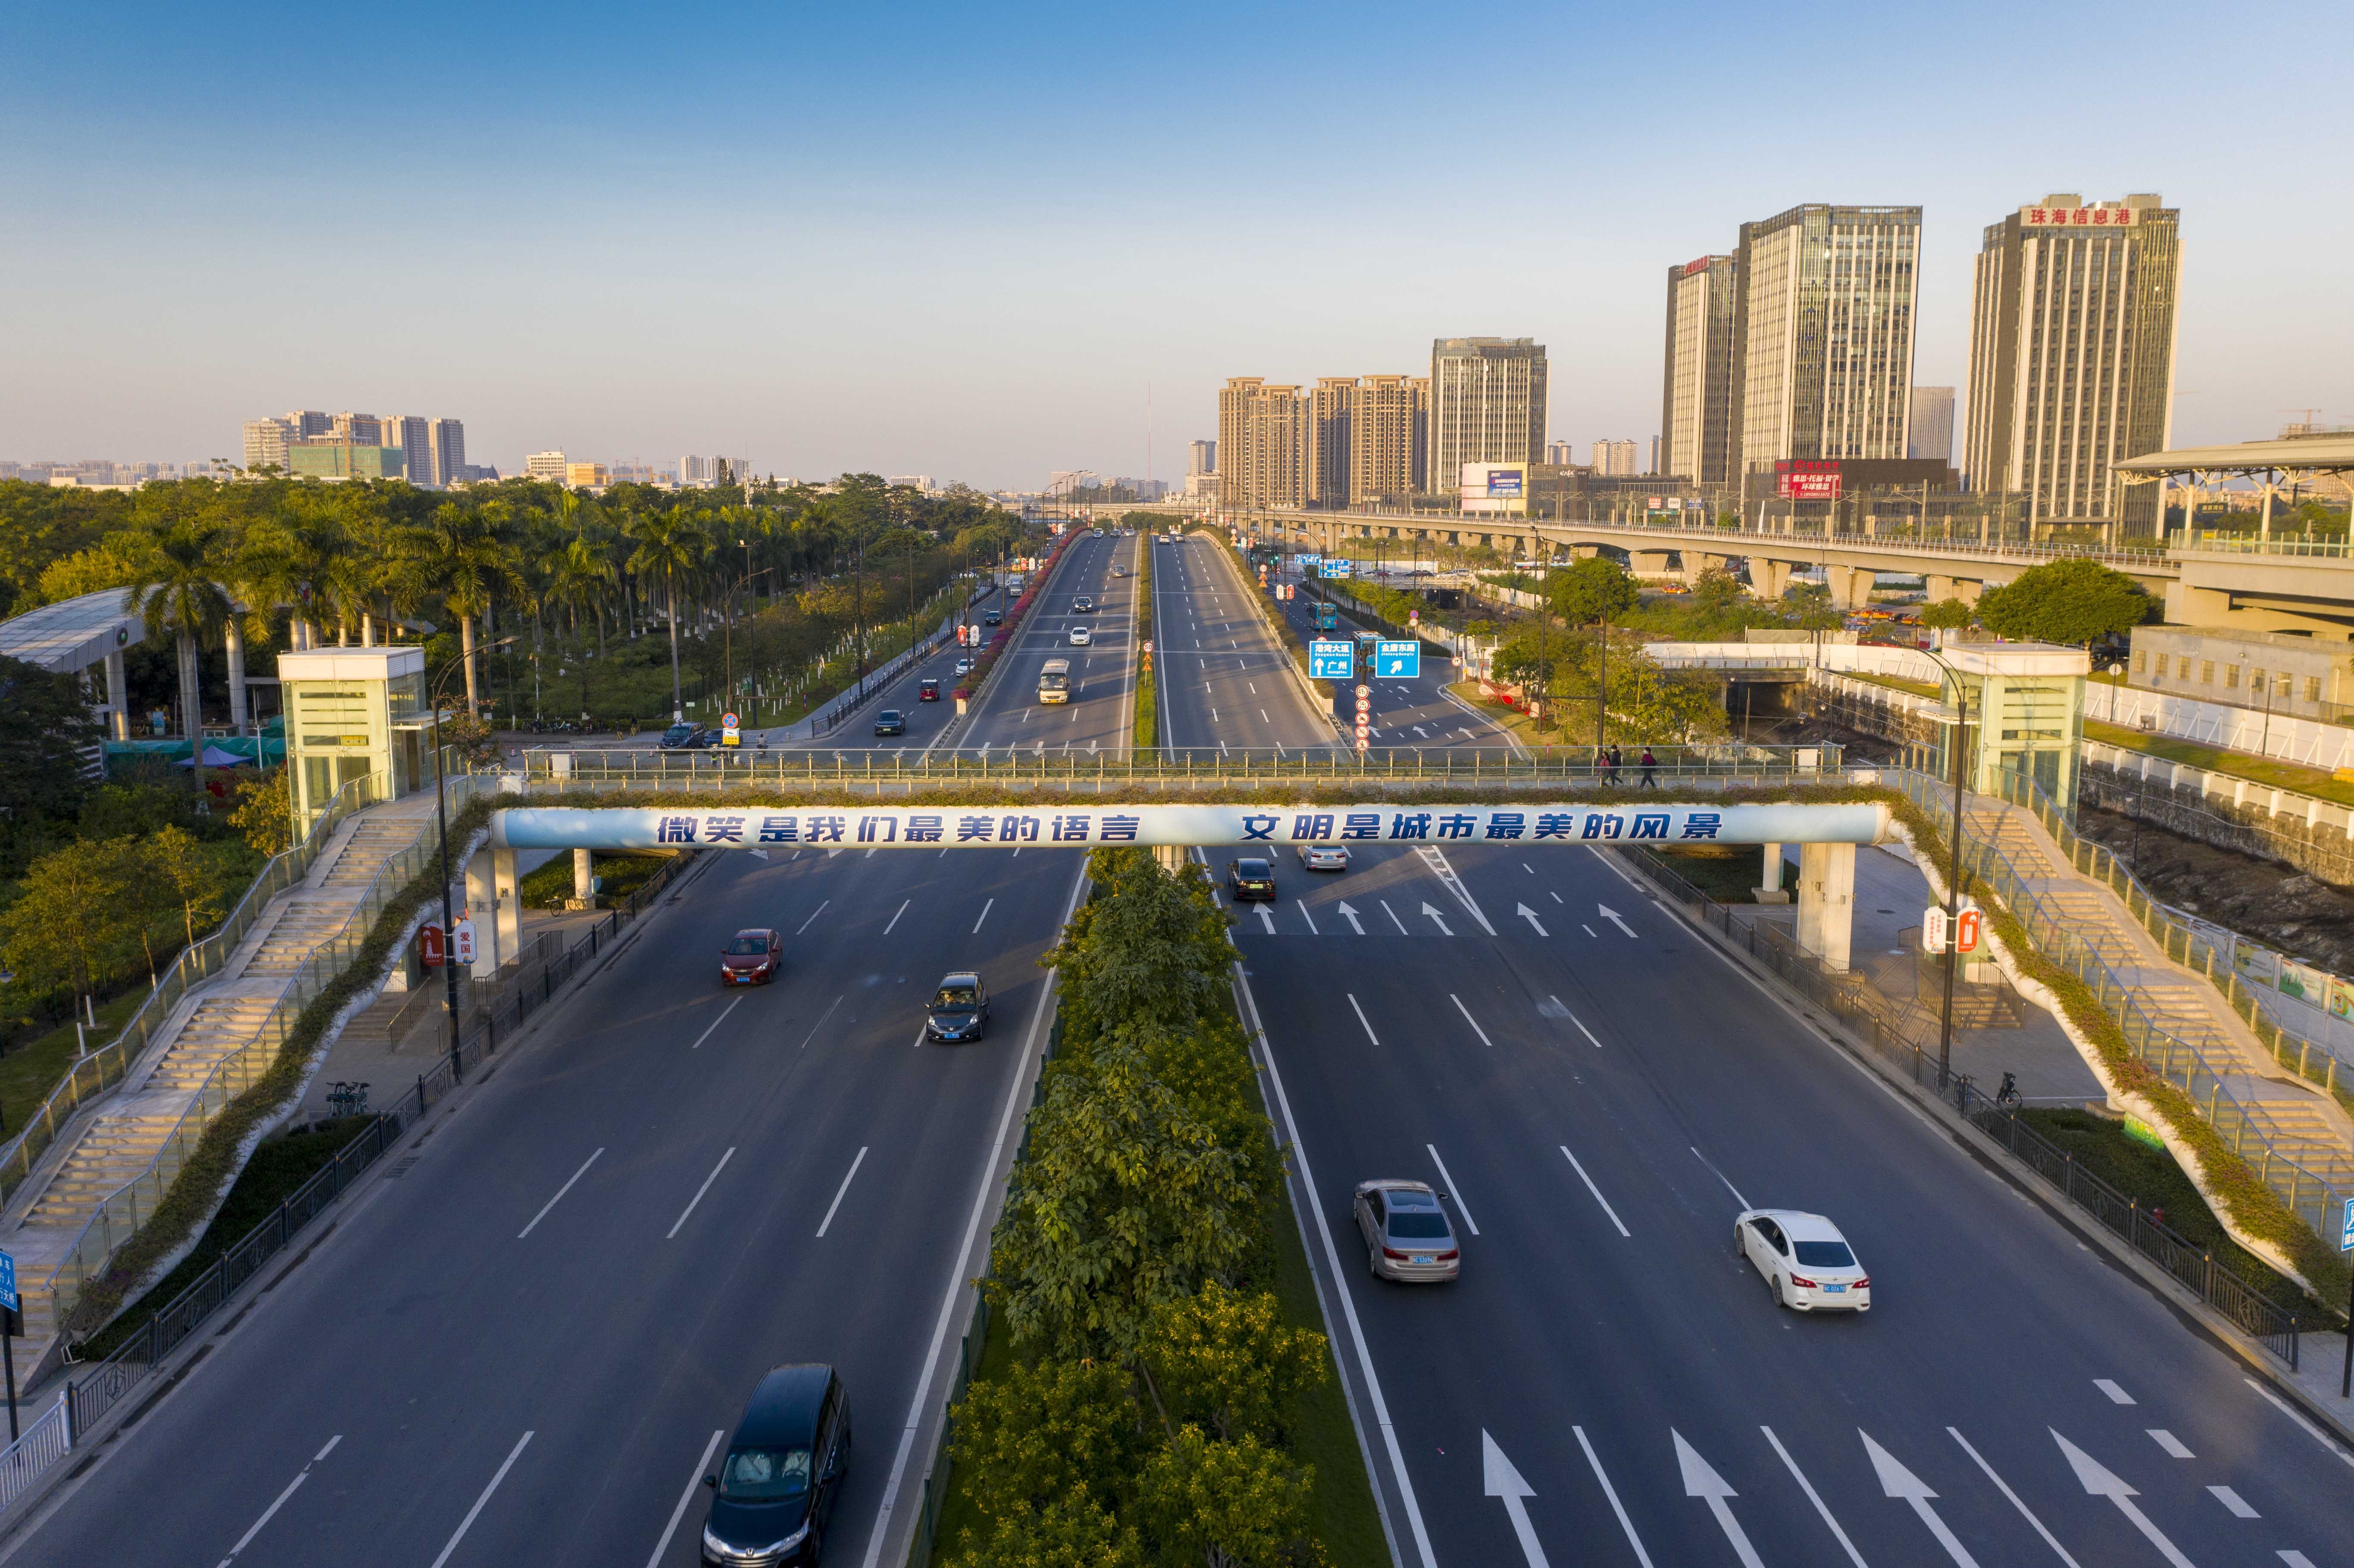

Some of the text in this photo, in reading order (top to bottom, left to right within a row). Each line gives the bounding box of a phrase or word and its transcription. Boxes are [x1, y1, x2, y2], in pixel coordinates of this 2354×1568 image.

[2030, 208, 2130, 224] 珠海信息港
[1315, 644, 1349, 653] 港湾大道
[1381, 644, 1415, 652] 金唐东路
[1327, 661, 1347, 669] 广州
[657, 815, 1140, 842] 微笑是我们最美的语言
[1239, 813, 1722, 840] 文明是城市最美的风景
[460, 932, 470, 953] 爱国
